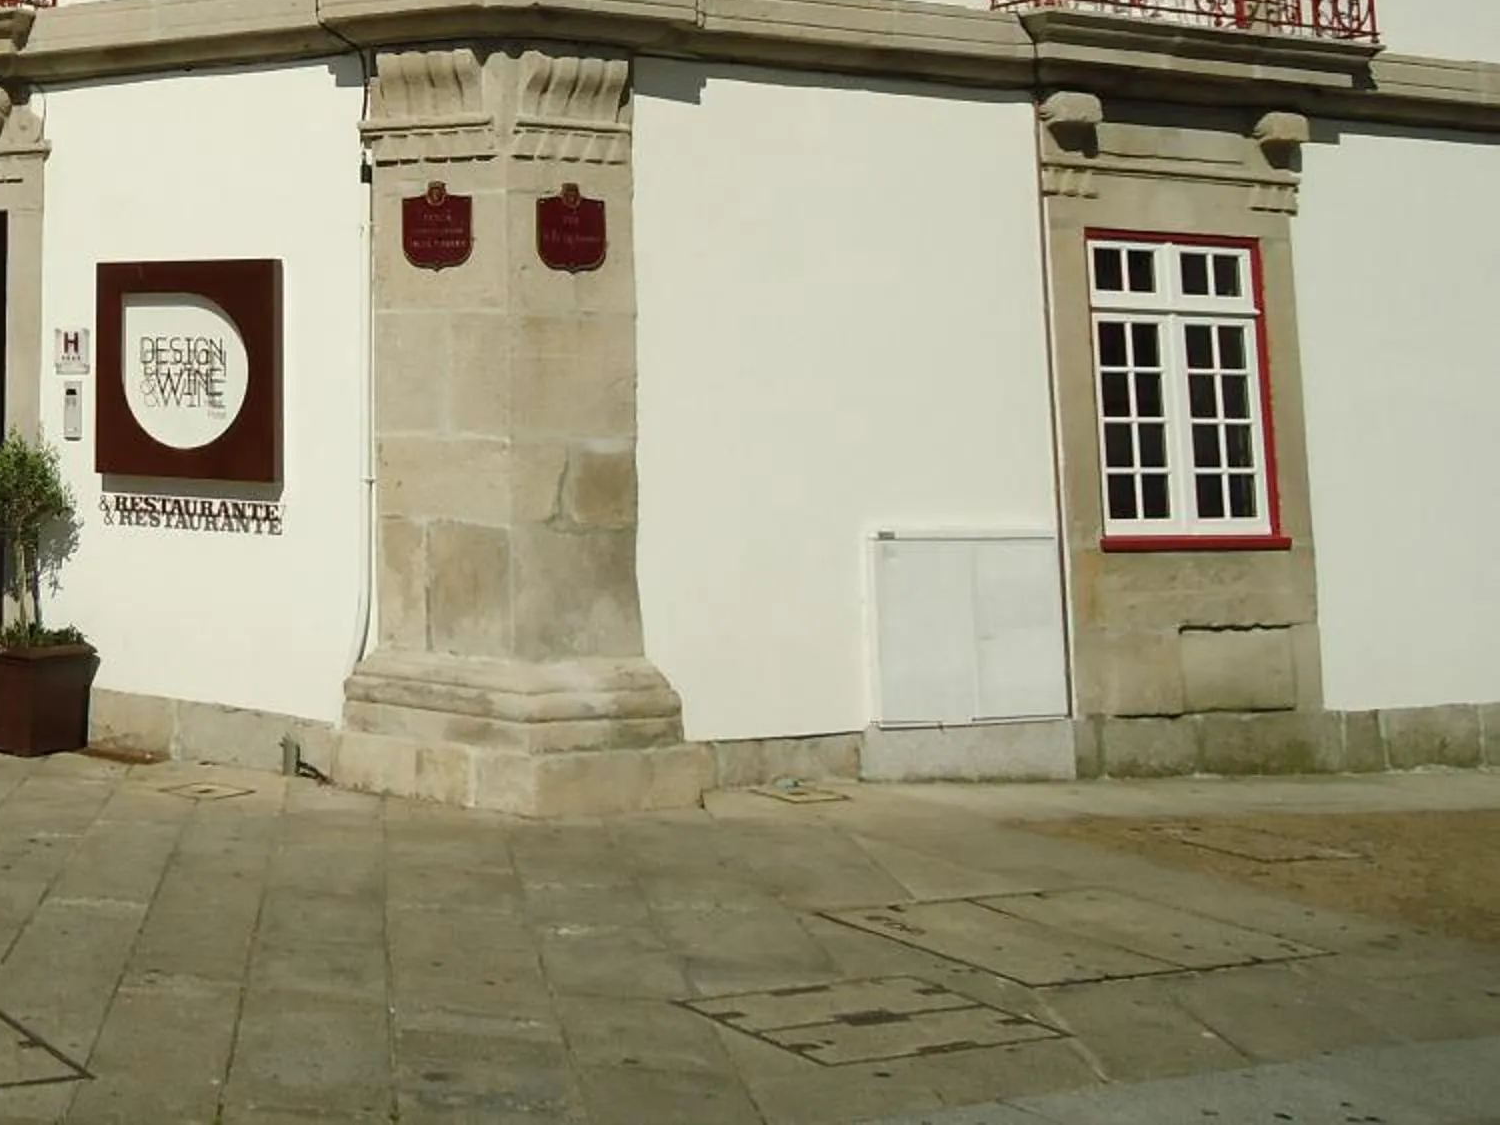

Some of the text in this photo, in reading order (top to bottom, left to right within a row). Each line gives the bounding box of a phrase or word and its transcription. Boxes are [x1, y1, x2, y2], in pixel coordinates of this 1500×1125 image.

[64, 332, 79, 354] H
[140, 336, 225, 366] DESIGN
[115, 495, 279, 521] RESTAURANTE
